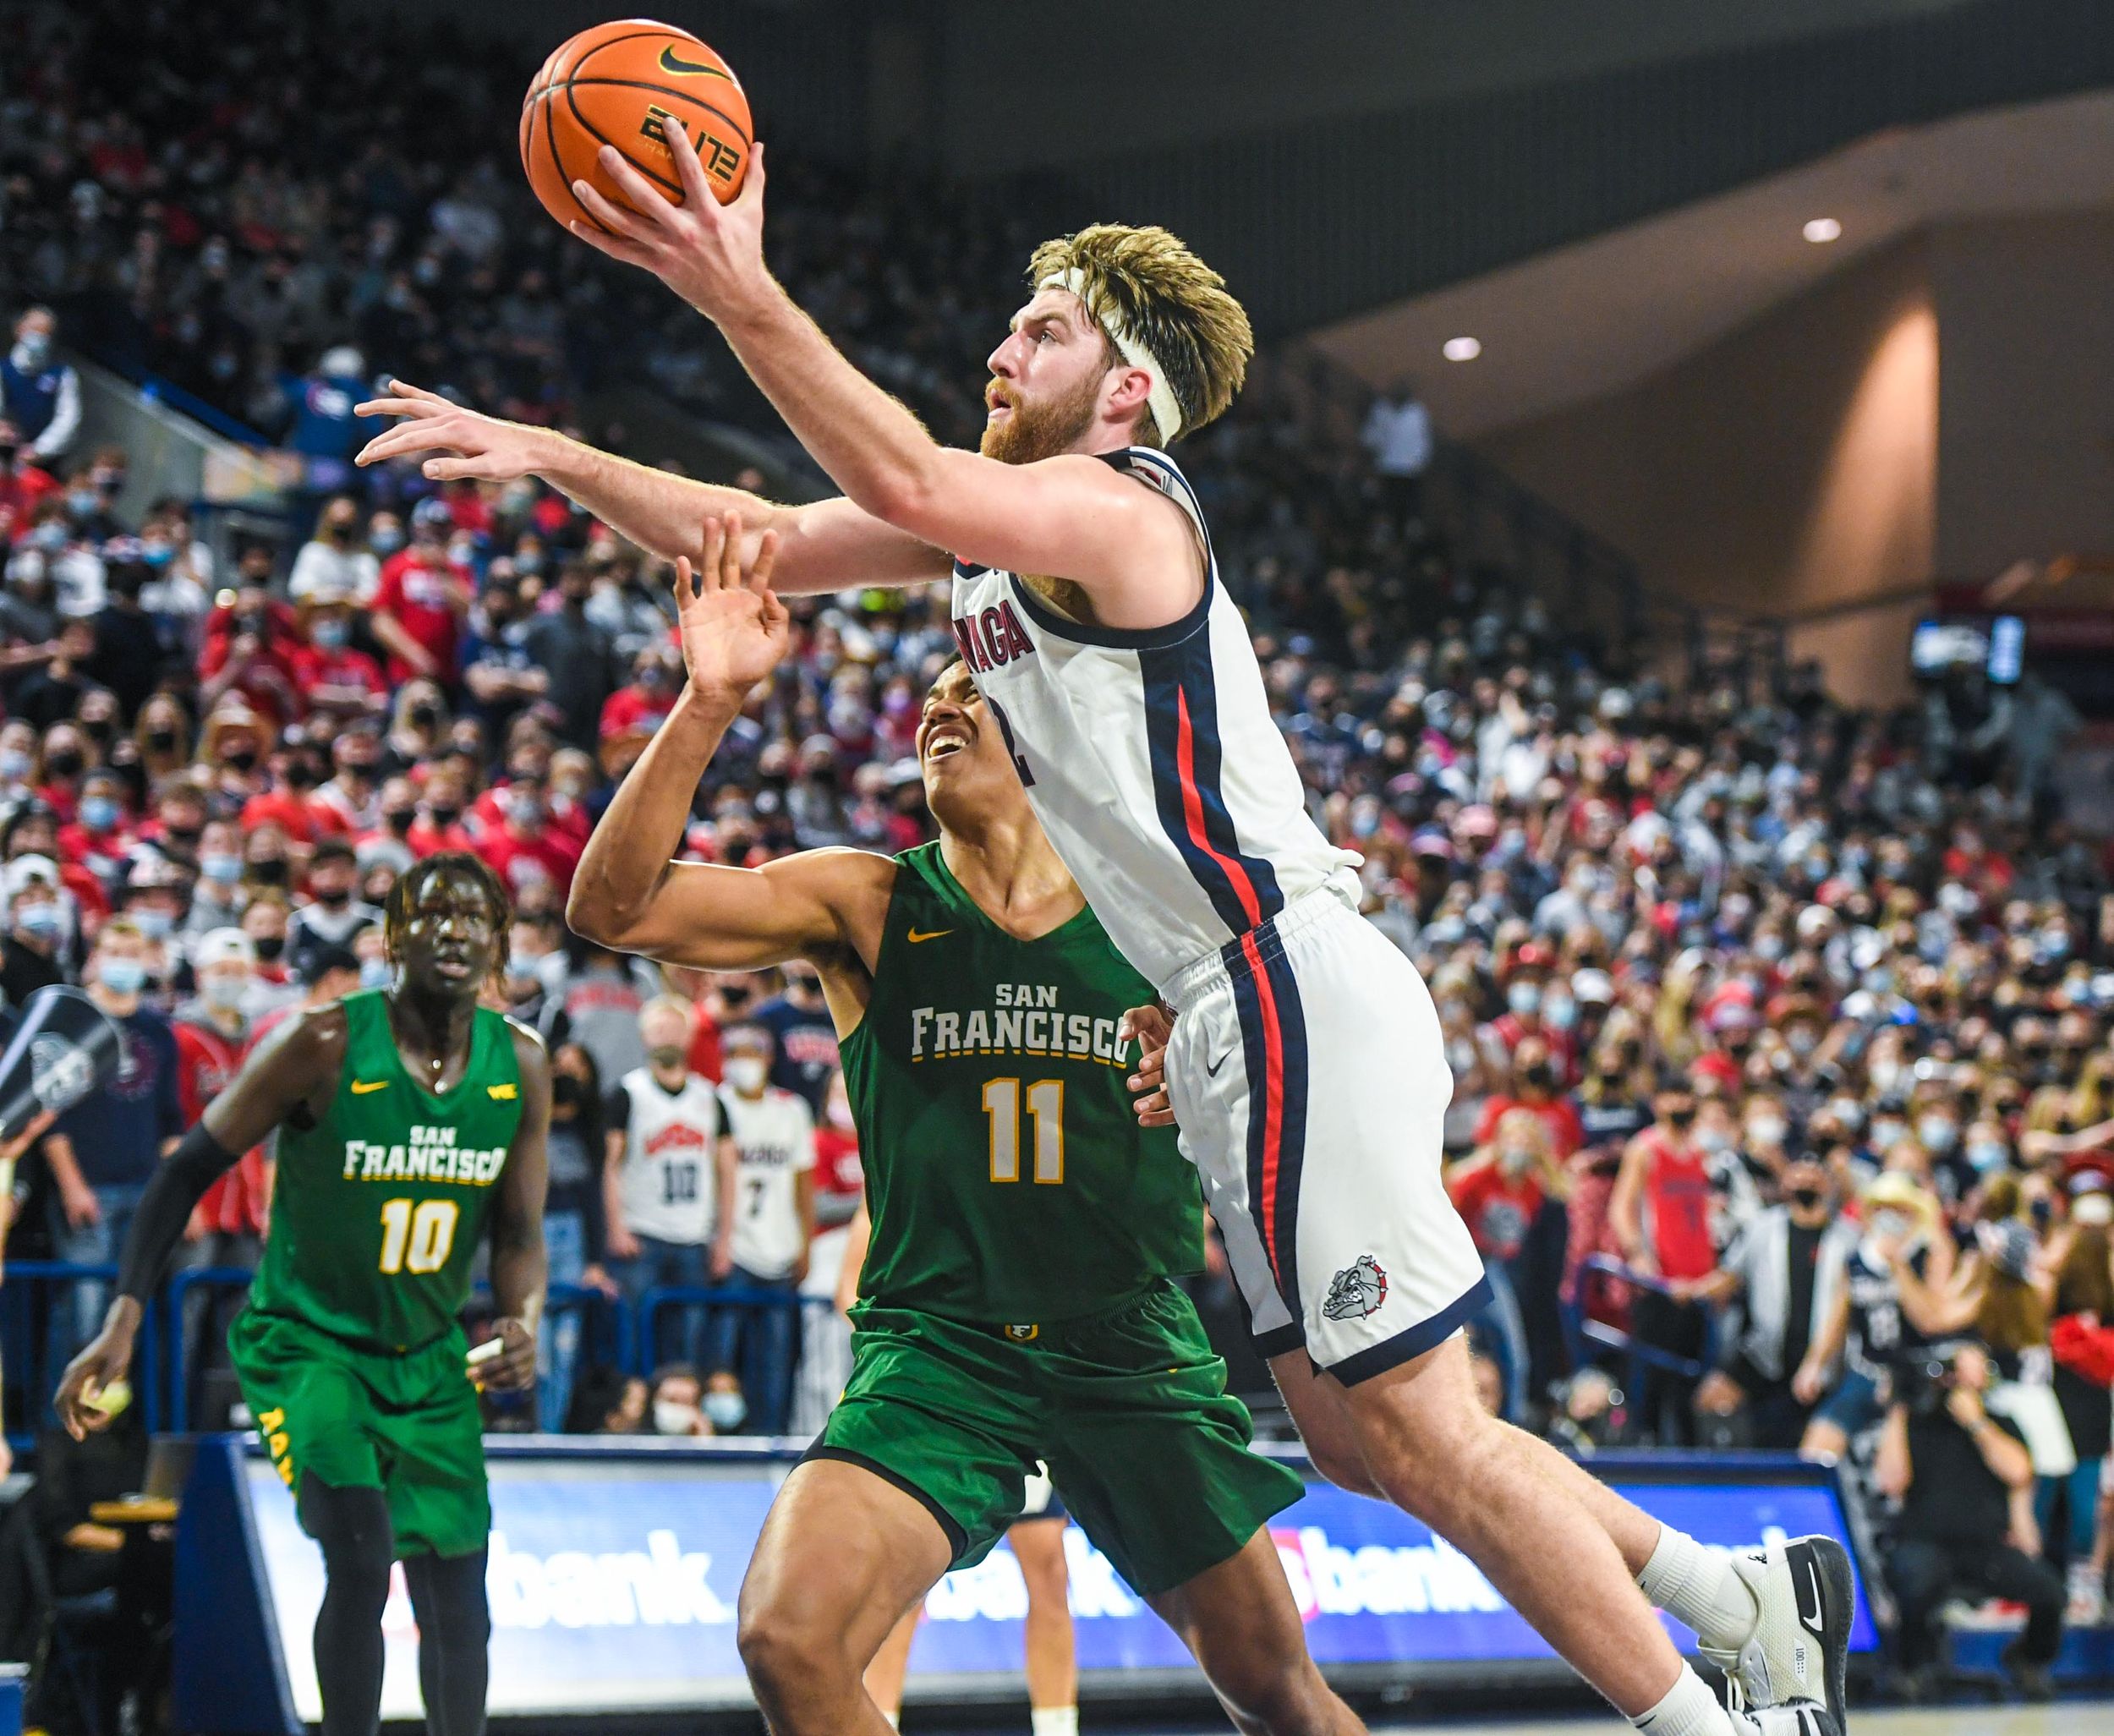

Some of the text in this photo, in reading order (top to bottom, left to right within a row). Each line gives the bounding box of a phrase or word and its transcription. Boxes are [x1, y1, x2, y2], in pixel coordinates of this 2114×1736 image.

[640, 103, 741, 182] EITE
[995, 983, 1057, 1008] SAN
[409, 1125, 457, 1147] SAN
[982, 1076, 1065, 1185] 11
[342, 1140, 507, 1186] FRANCISCO
[380, 1197, 460, 1275] 10
